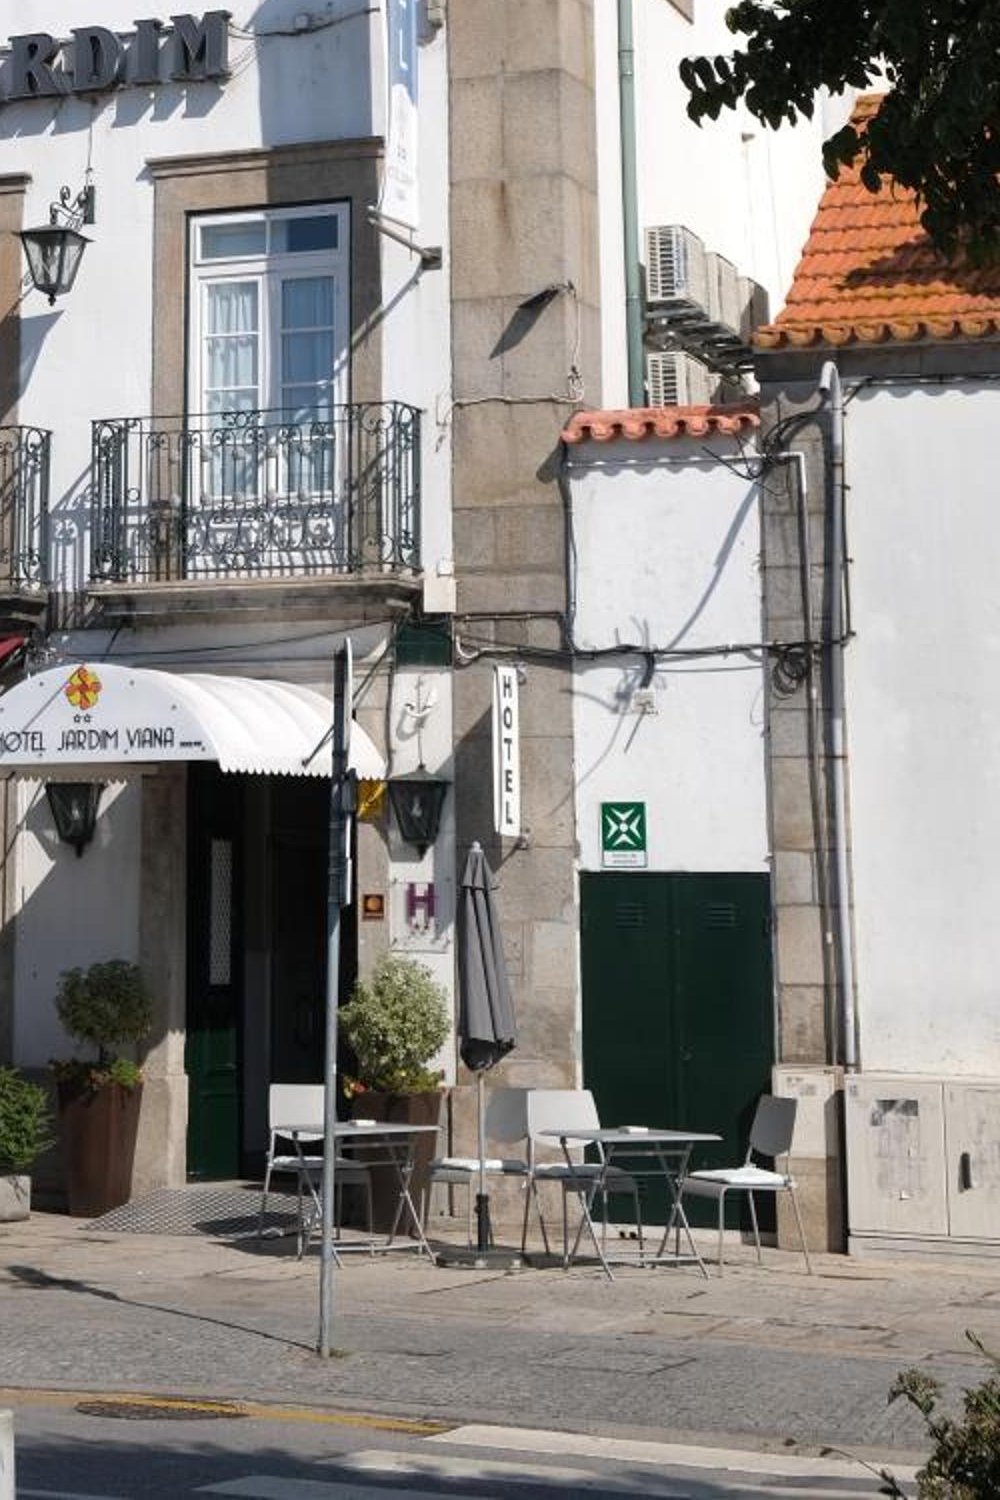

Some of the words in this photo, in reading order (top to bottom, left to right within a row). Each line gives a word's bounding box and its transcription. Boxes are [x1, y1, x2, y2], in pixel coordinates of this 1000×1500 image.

[57, 728, 119, 751] JARDIM
[126, 727, 174, 749] VIANA
[503, 674, 514, 825] HOTEL
